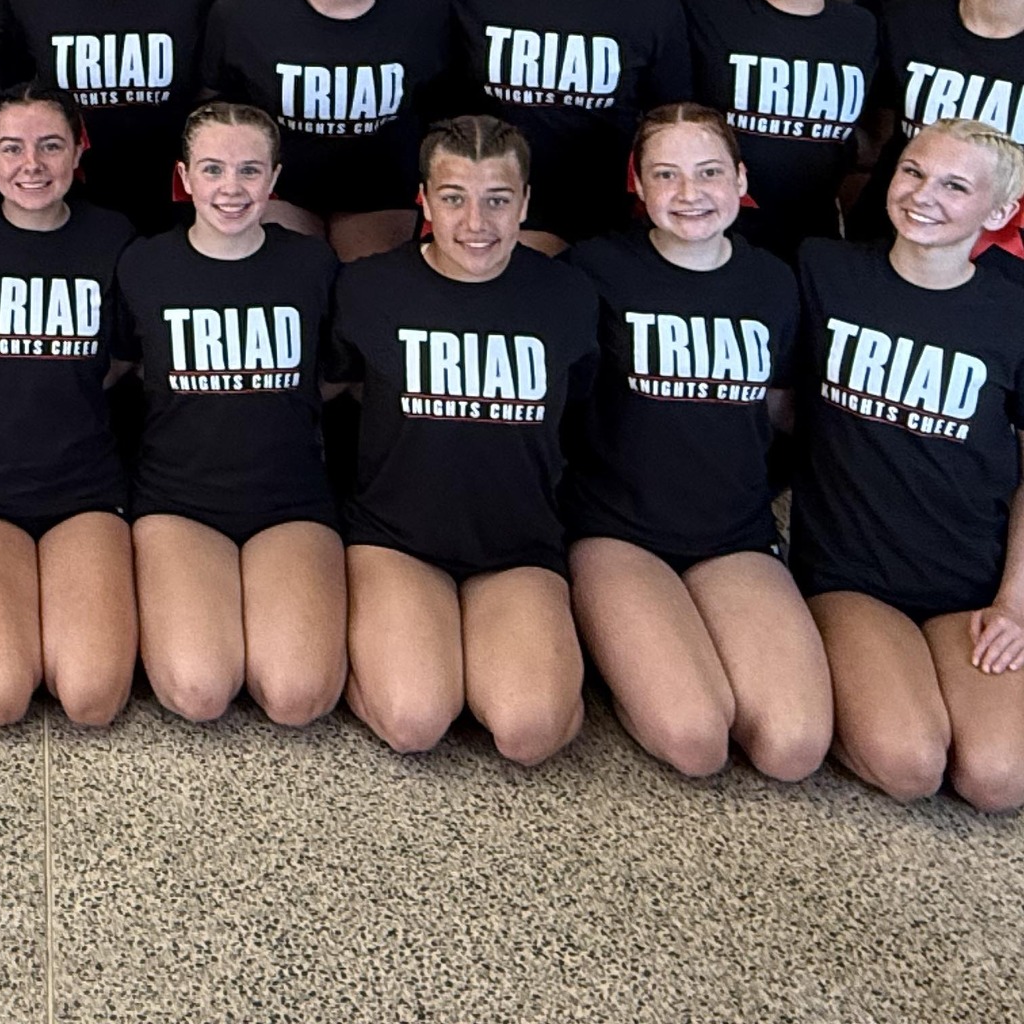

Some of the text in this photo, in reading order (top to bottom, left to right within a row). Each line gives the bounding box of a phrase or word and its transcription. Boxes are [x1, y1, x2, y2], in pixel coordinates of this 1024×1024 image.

[51, 33, 174, 89] TRIAD
[485, 26, 621, 94] TRIAD
[728, 54, 865, 123] TRIAD
[276, 62, 405, 120] TRIAD
[485, 85, 555, 105] KNIGHTS
[905, 61, 1024, 144] TRIA
[727, 112, 804, 137] KNIGHTS
[164, 306, 302, 370] TRIAD
[398, 329, 547, 401] TRIAD
[626, 312, 771, 382] TRIAD
[169, 374, 243, 390] KNIGHTS
[628, 376, 767, 401] KNIGHTS CHEER
[827, 317, 988, 419] TRIAD
[401, 396, 545, 422] KNIGHTS CHEER
[821, 382, 970, 440] KNIGHTS CHEER
